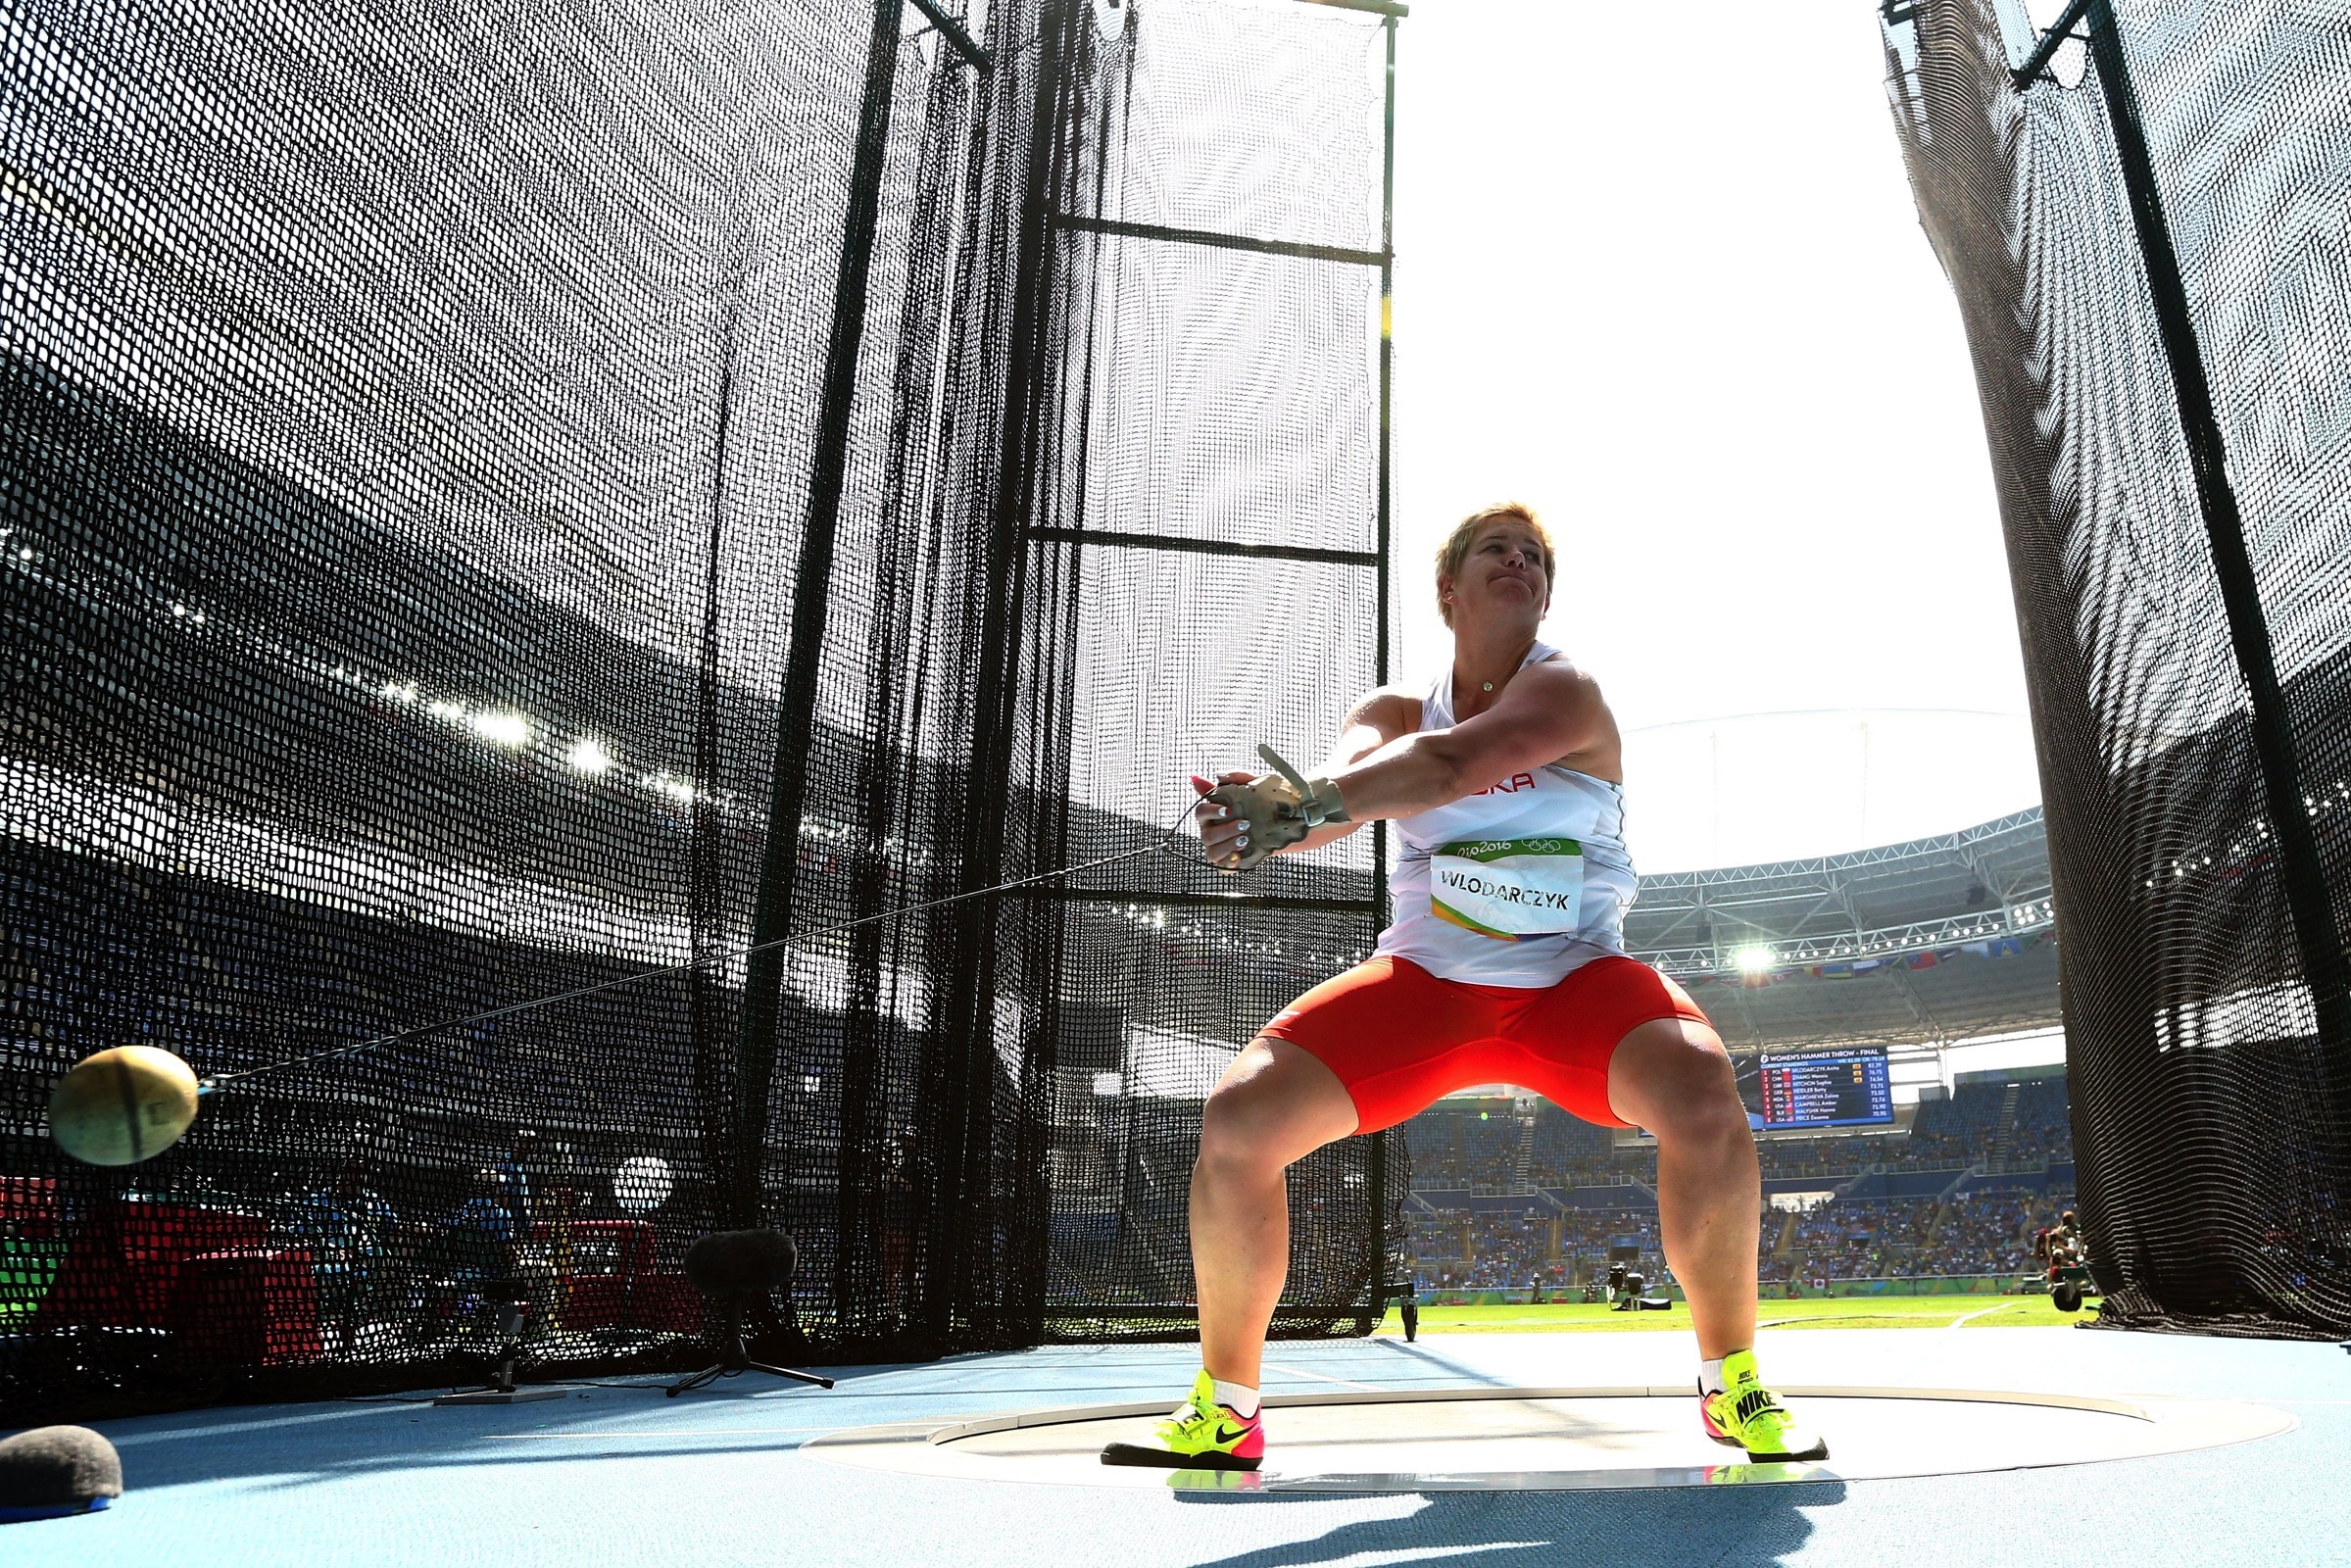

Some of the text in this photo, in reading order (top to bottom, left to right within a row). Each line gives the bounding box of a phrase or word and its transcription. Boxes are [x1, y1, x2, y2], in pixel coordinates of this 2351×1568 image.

[1441, 870, 1570, 910] WLODARCZYK
[1738, 1370, 1751, 1380] NIKE
[1736, 1390, 1777, 1425] NIKE
